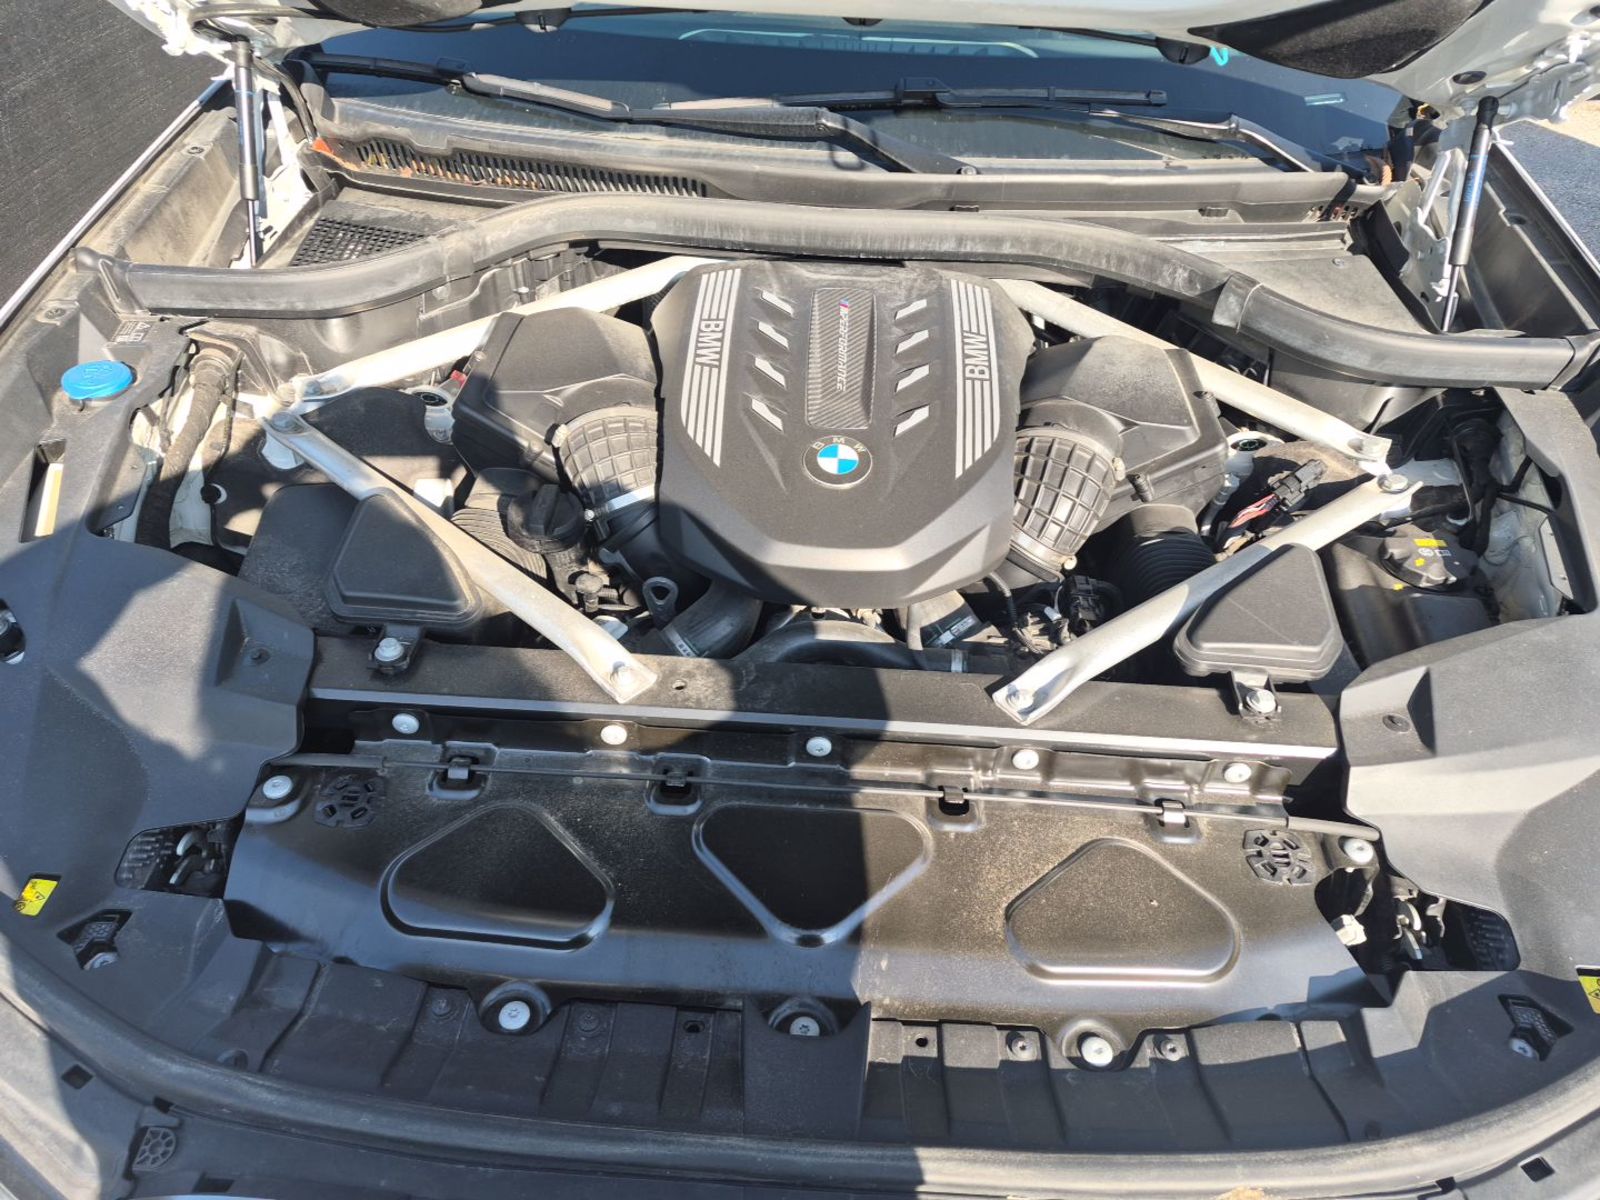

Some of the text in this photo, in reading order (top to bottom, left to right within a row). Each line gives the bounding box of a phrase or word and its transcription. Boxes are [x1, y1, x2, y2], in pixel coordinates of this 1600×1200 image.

[695, 320, 724, 366] BMW
[962, 332, 990, 379] BMW
[811, 437, 867, 452] BMW
